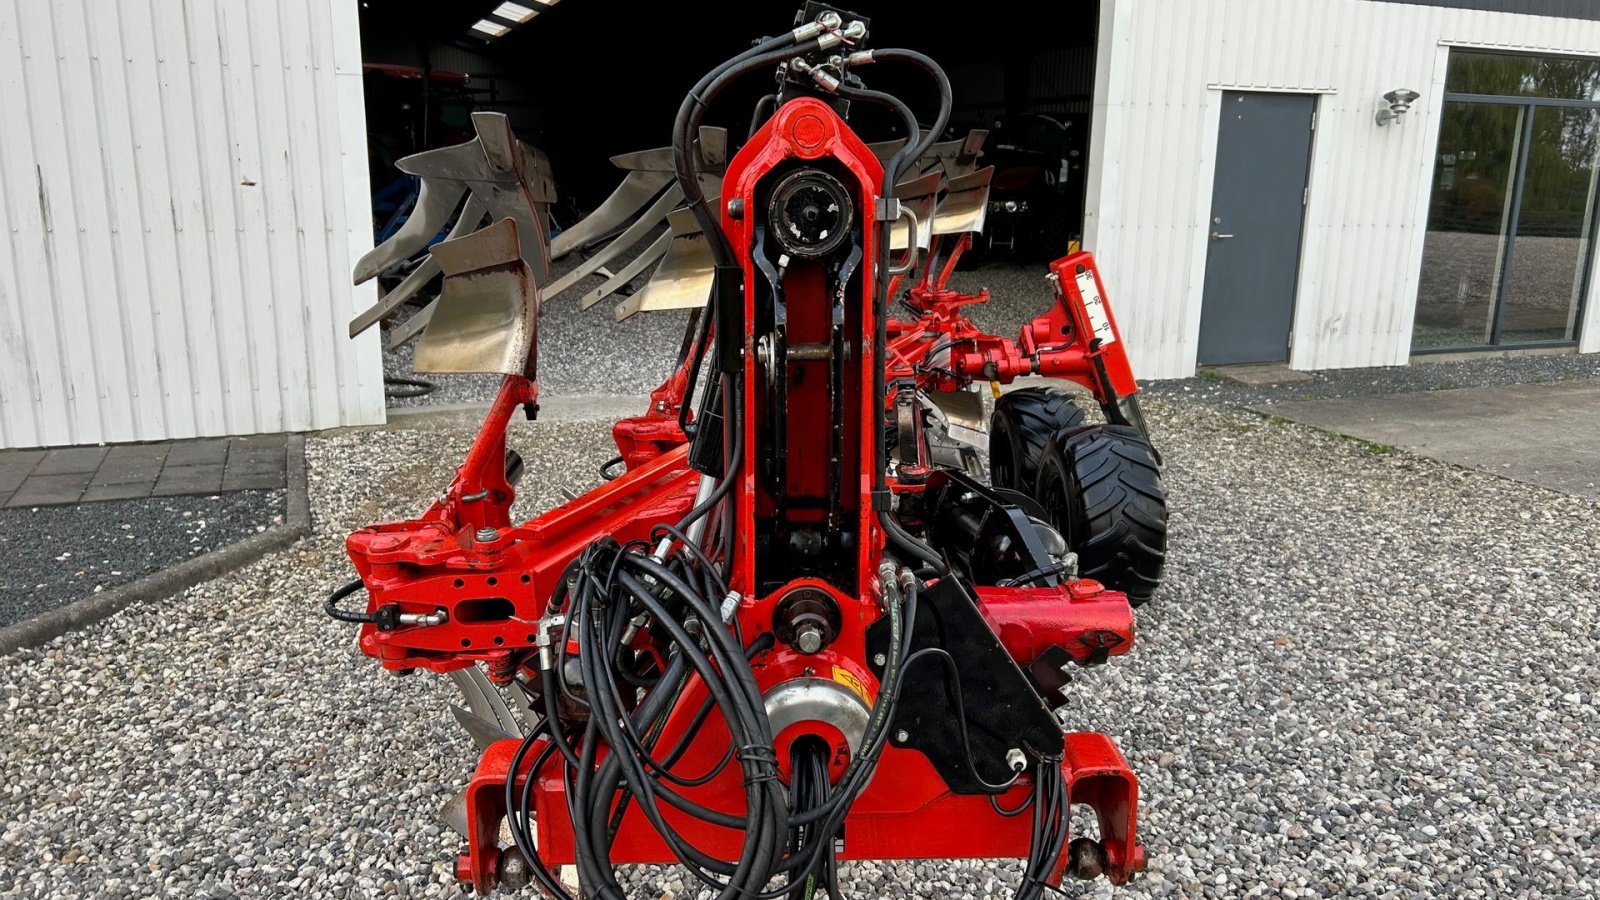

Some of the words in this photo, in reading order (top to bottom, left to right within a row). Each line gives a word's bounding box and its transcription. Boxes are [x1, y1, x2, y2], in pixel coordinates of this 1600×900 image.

[1085, 270, 1093, 280] 30
[1093, 295, 1101, 305] 20
[1102, 322, 1110, 331] 10
